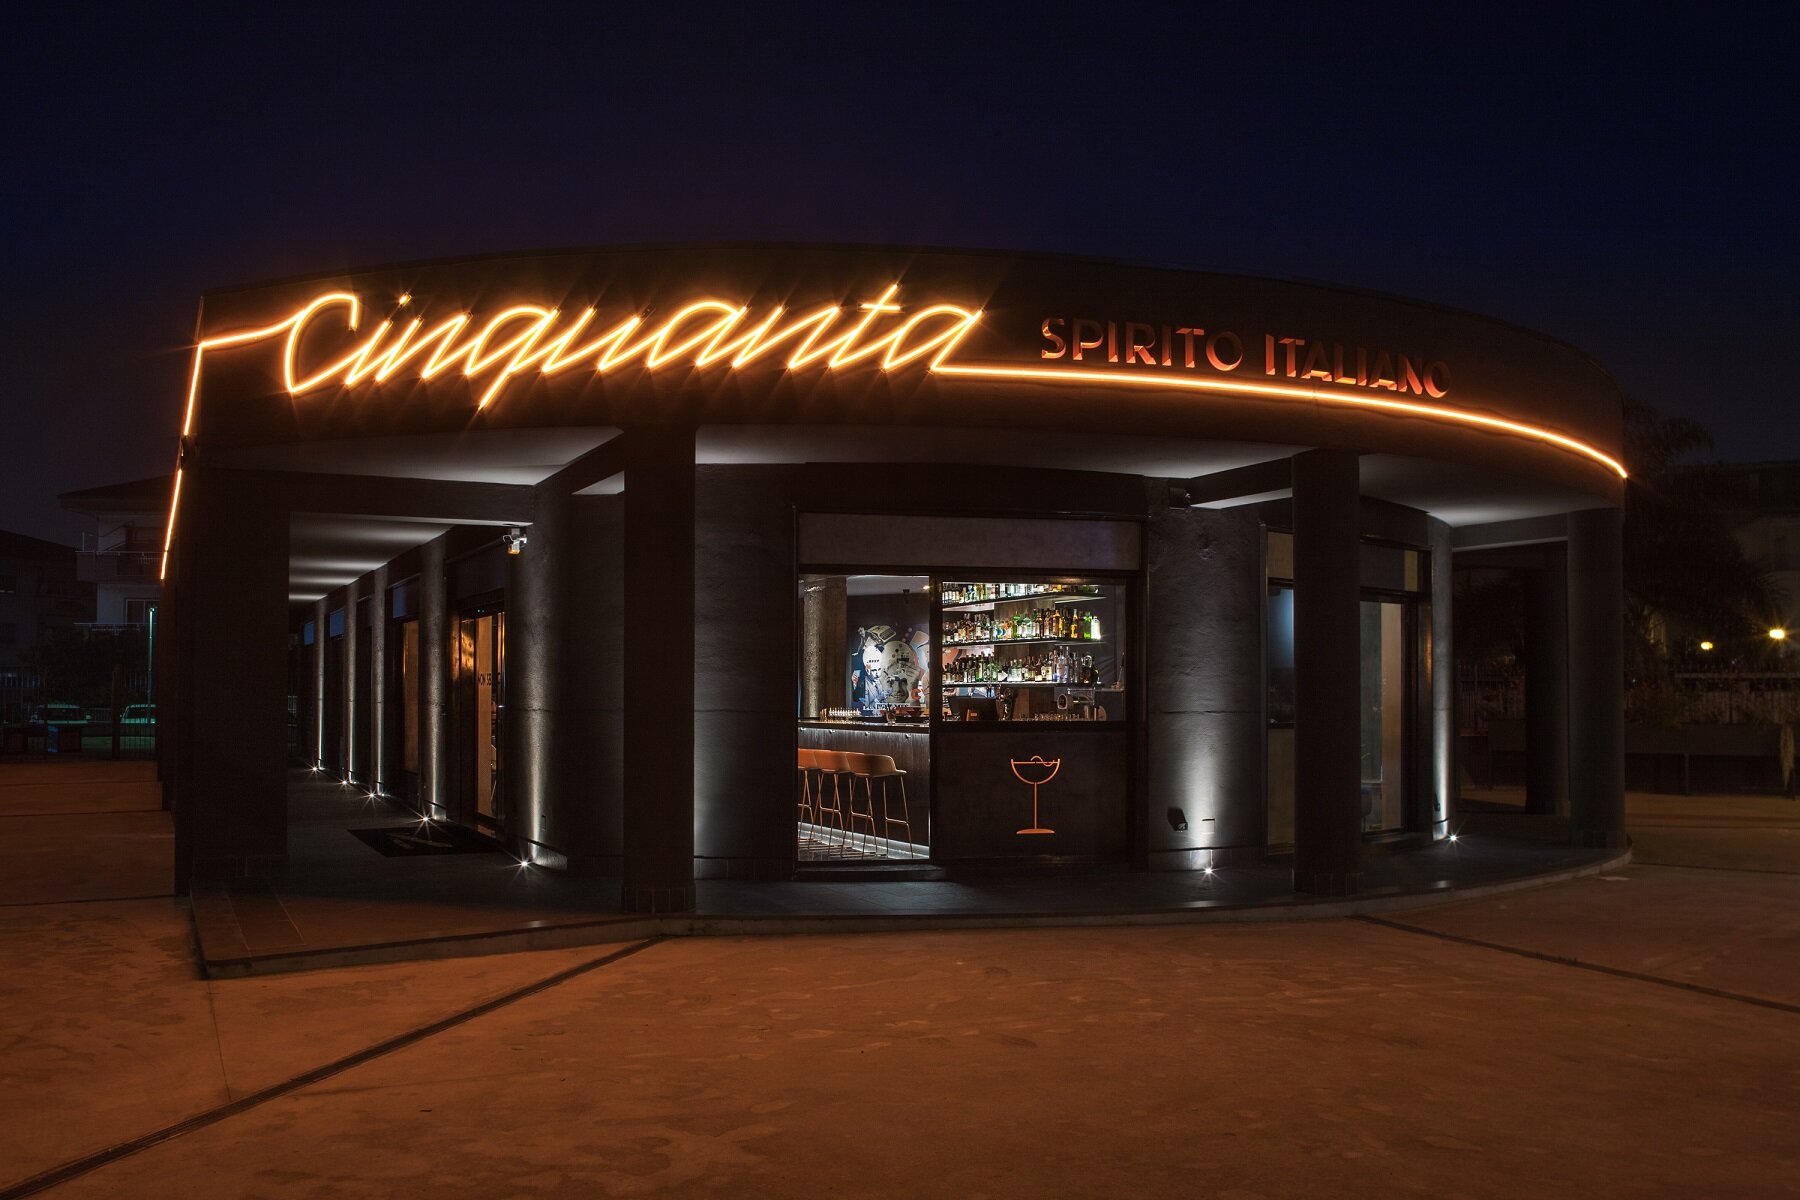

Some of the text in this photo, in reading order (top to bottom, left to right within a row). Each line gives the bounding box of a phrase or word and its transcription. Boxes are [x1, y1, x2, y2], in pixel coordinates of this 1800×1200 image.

[284, 281, 983, 412] Cinquanta
[1040, 316, 1451, 399] SPIRITO ITALIANO
